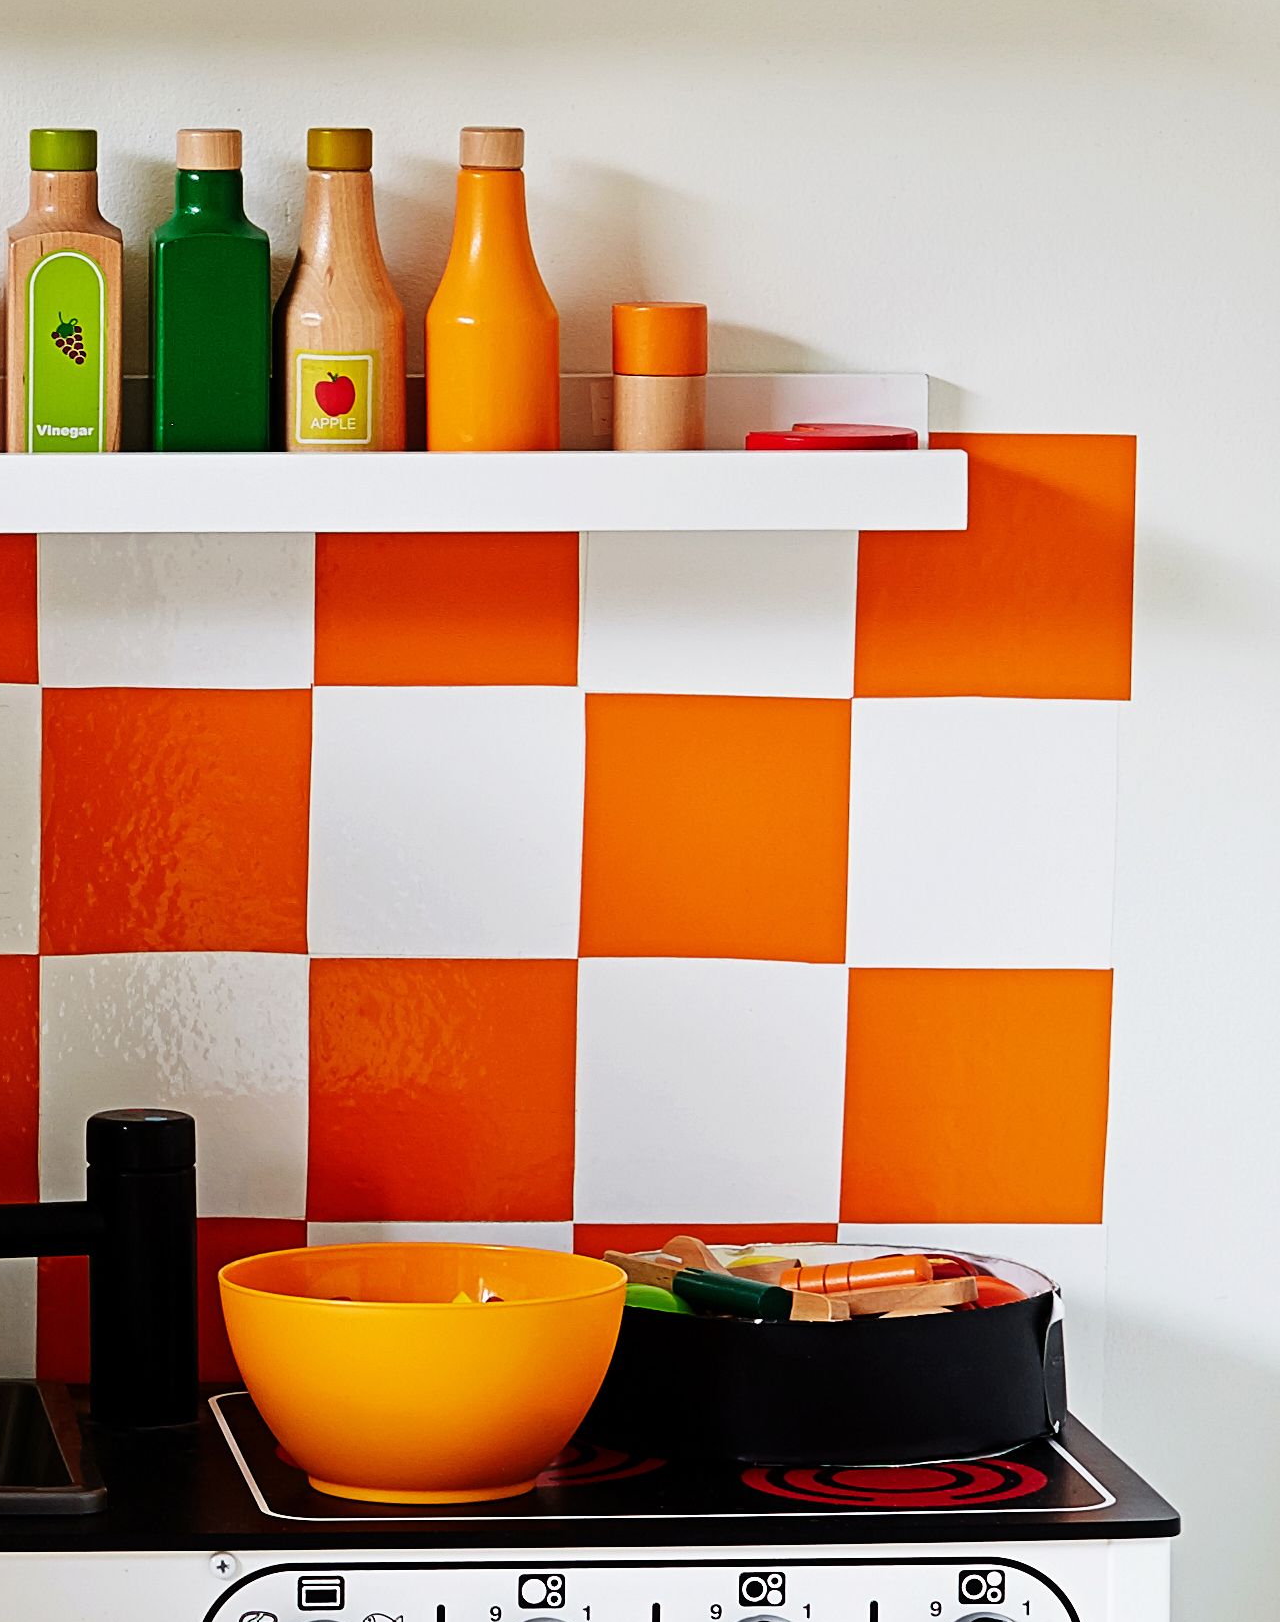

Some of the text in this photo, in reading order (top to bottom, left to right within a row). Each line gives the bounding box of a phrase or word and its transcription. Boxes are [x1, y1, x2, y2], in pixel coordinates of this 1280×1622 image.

[310, 416, 356, 430] APPLE
[36, 424, 94, 439] Vinegar
[490, 1606, 501, 1621] 9
[583, 1606, 590, 1620] 1
[711, 1604, 722, 1619] 9
[803, 1604, 810, 1618] 1
[930, 1601, 942, 1616] 9
[1022, 1600, 1030, 1615] 1
